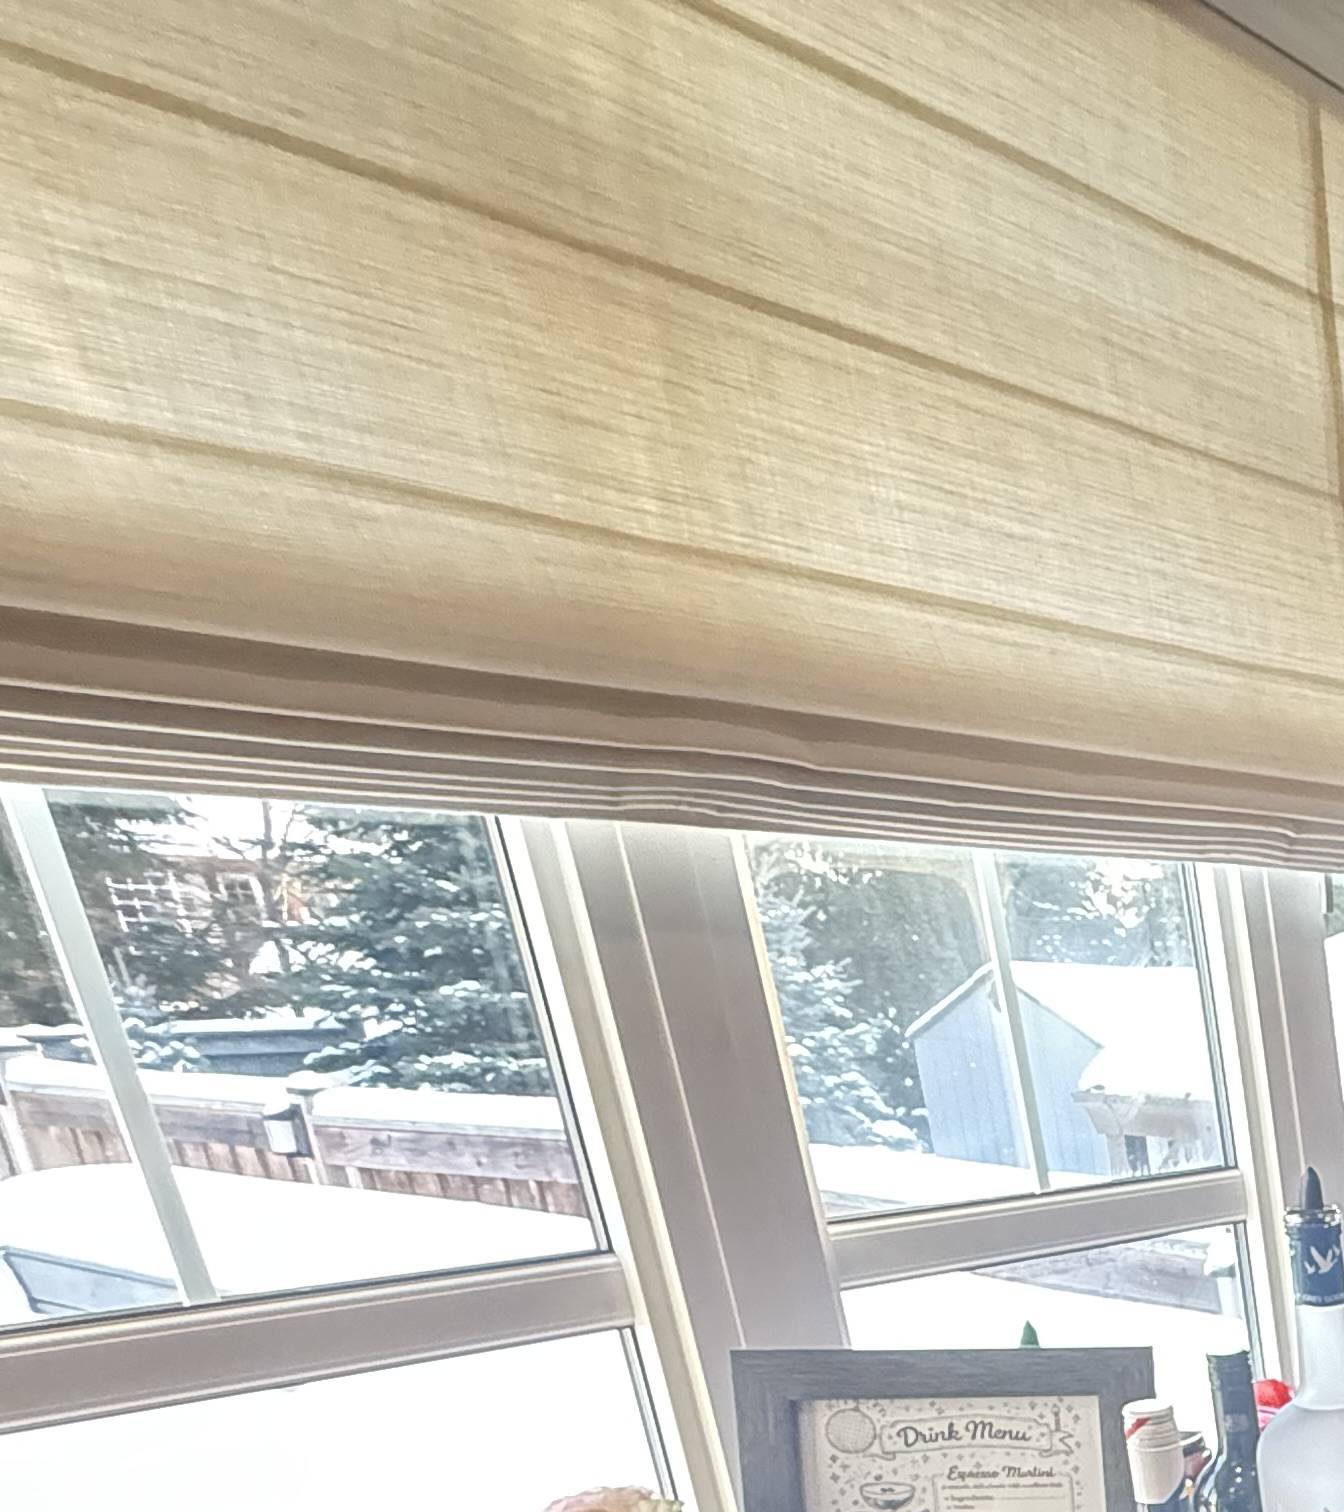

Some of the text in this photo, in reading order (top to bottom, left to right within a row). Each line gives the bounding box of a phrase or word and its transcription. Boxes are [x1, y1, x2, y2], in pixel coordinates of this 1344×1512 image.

[896, 1420, 1032, 1447] Drink Menu
[947, 1465, 1056, 1482] Espresso Martini
